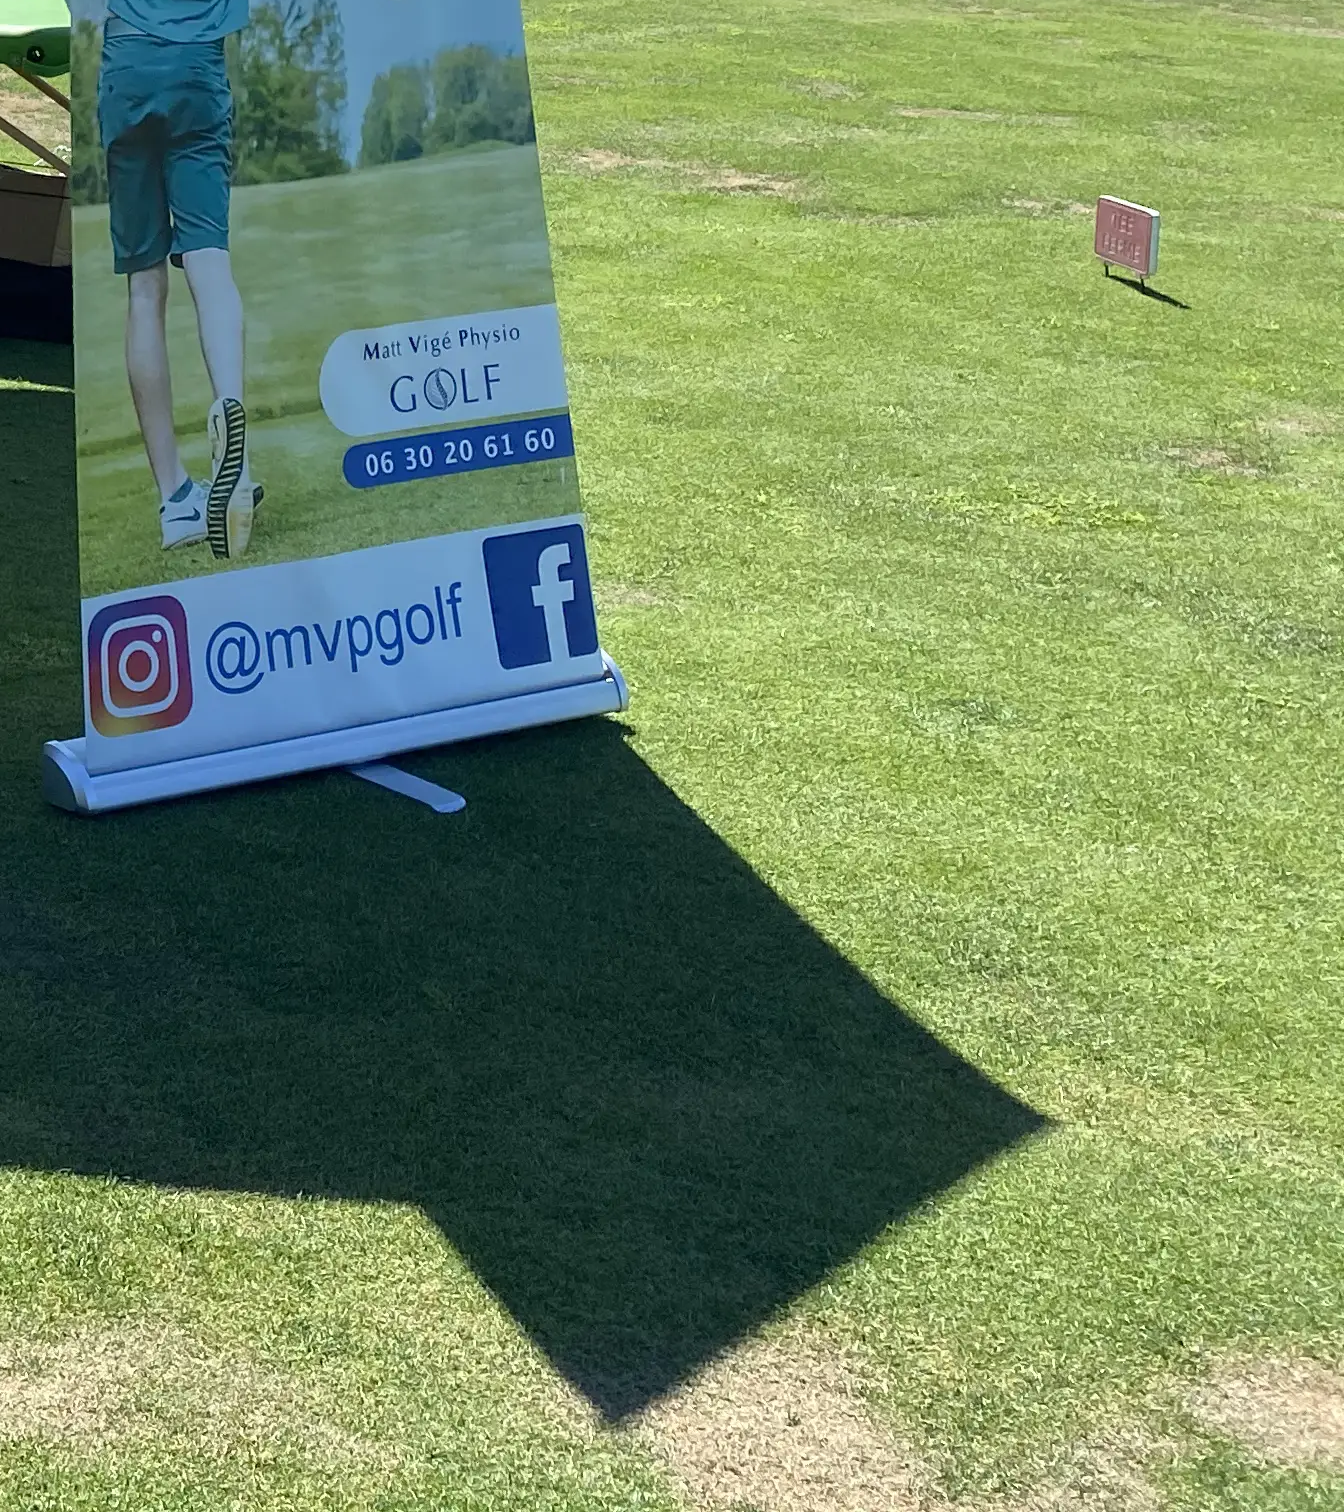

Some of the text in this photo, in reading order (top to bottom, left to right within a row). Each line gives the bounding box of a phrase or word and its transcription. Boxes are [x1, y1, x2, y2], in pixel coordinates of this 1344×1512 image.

[362, 323, 521, 363] Matt Vigé Physio
[389, 363, 502, 413] GOLF
[365, 427, 556, 478] 06 30 20 61 60
[205, 582, 463, 696] @mvpgolf
